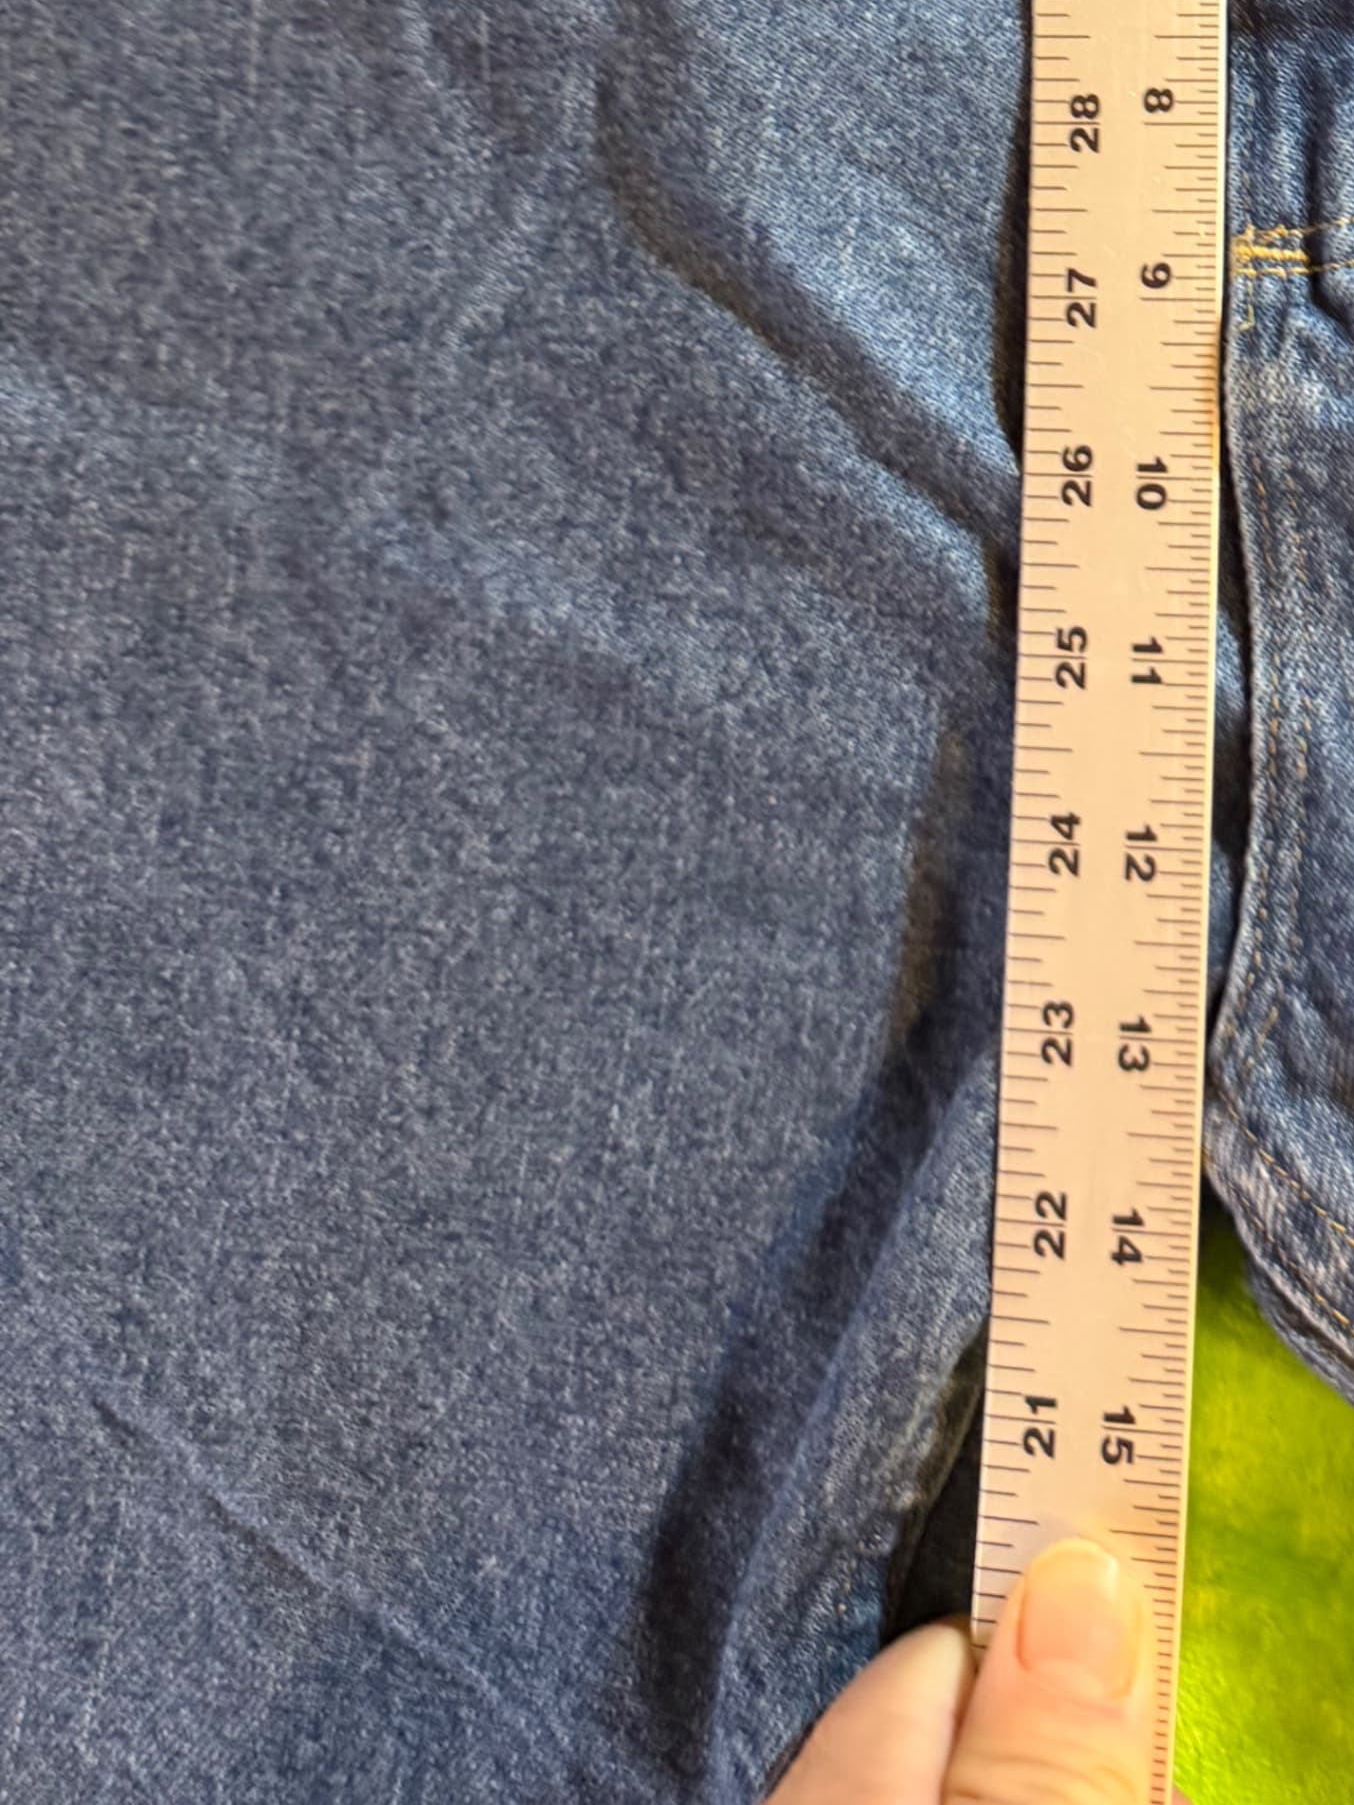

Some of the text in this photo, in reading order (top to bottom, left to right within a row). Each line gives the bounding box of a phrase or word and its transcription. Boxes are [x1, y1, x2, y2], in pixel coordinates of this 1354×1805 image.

[1068, 93, 1101, 154] 28
[1142, 87, 1176, 114] 8
[1065, 267, 1098, 329] 27
[1139, 261, 1174, 290] 9
[1060, 444, 1094, 508] 26
[1135, 456, 1169, 512] 10
[1054, 625, 1088, 690] 25
[1131, 635, 1165, 686] 11
[1047, 812, 1082, 878] 24
[1124, 824, 1159, 883] 12
[1039, 1001, 1075, 1068] 23
[1117, 1015, 1153, 1073] 13
[1032, 1190, 1068, 1261] 22
[1110, 1208, 1146, 1267] 14
[1021, 1394, 1058, 1460] 21
[1100, 1405, 1137, 1466] 15
